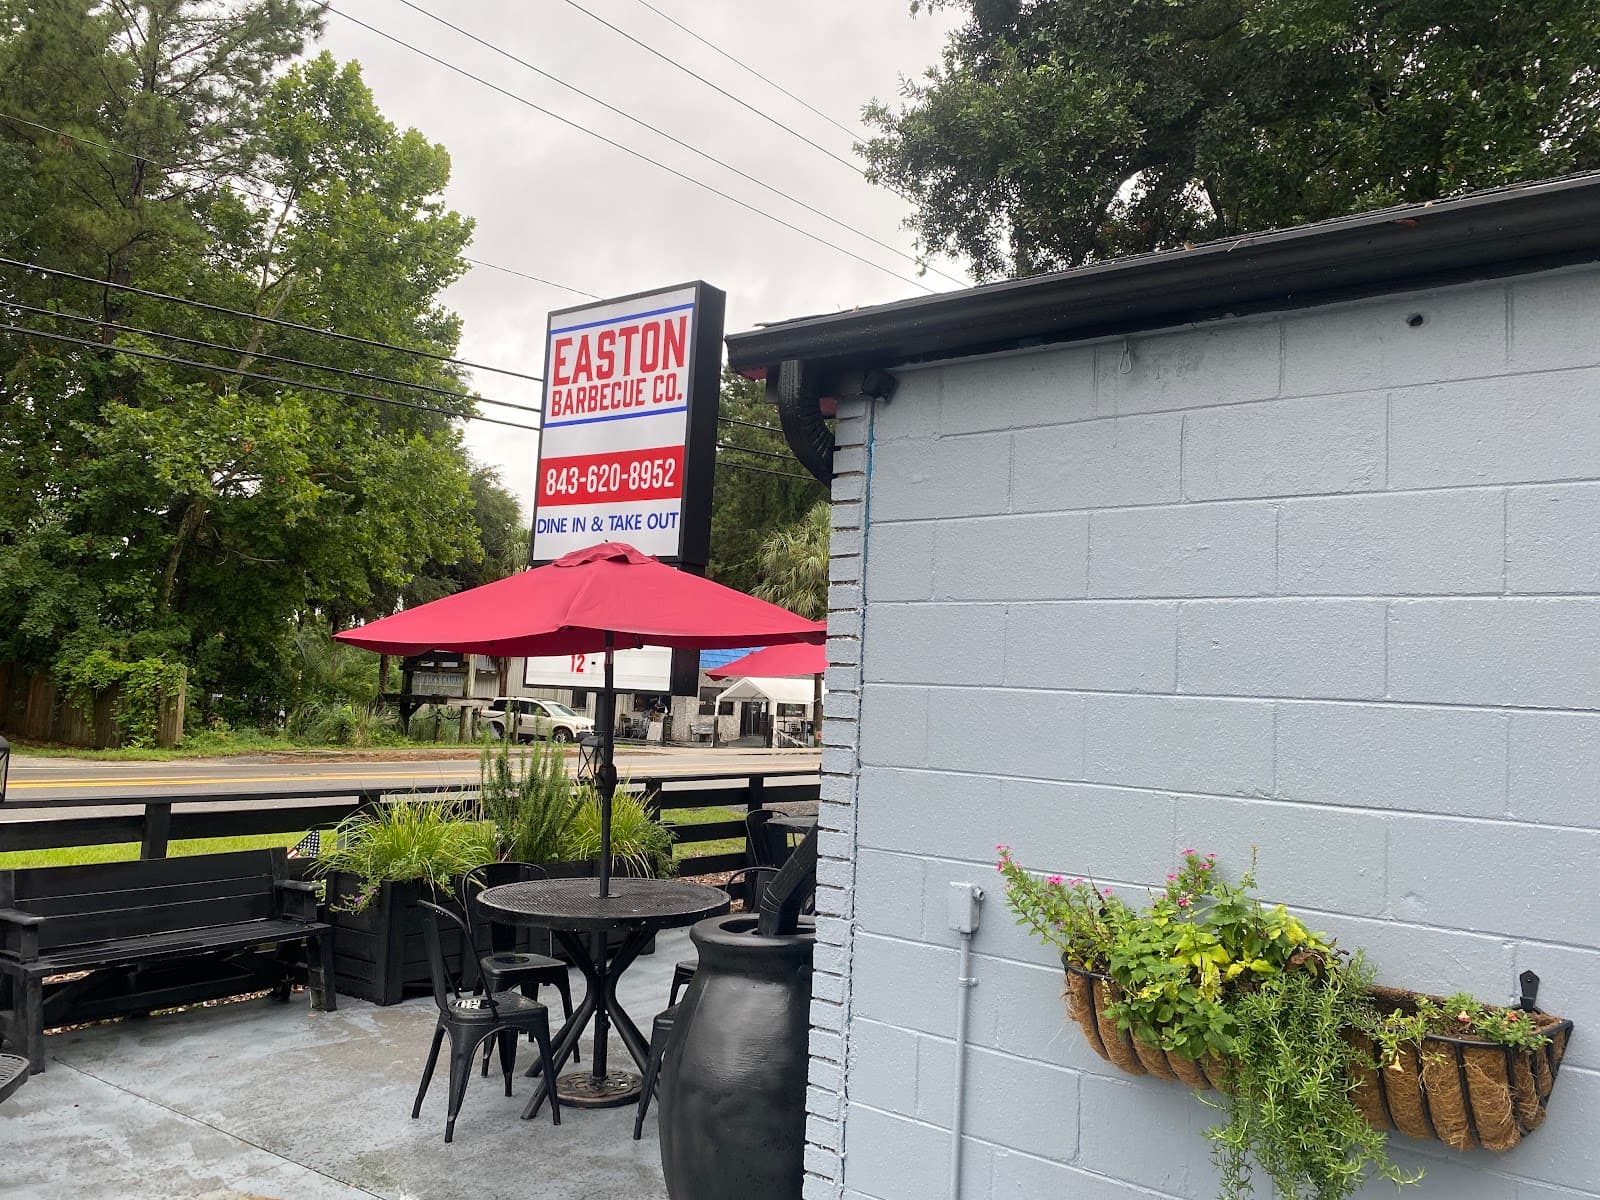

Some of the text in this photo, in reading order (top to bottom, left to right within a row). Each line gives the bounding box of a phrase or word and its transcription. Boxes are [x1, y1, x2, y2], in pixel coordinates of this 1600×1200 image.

[553, 316, 688, 387] EASTON
[551, 373, 683, 417] BARBECUE CO.
[545, 458, 676, 496] 843-620-8952
[537, 512, 679, 534] DINE IN & TAKE OUT
[570, 654, 585, 673] 12
